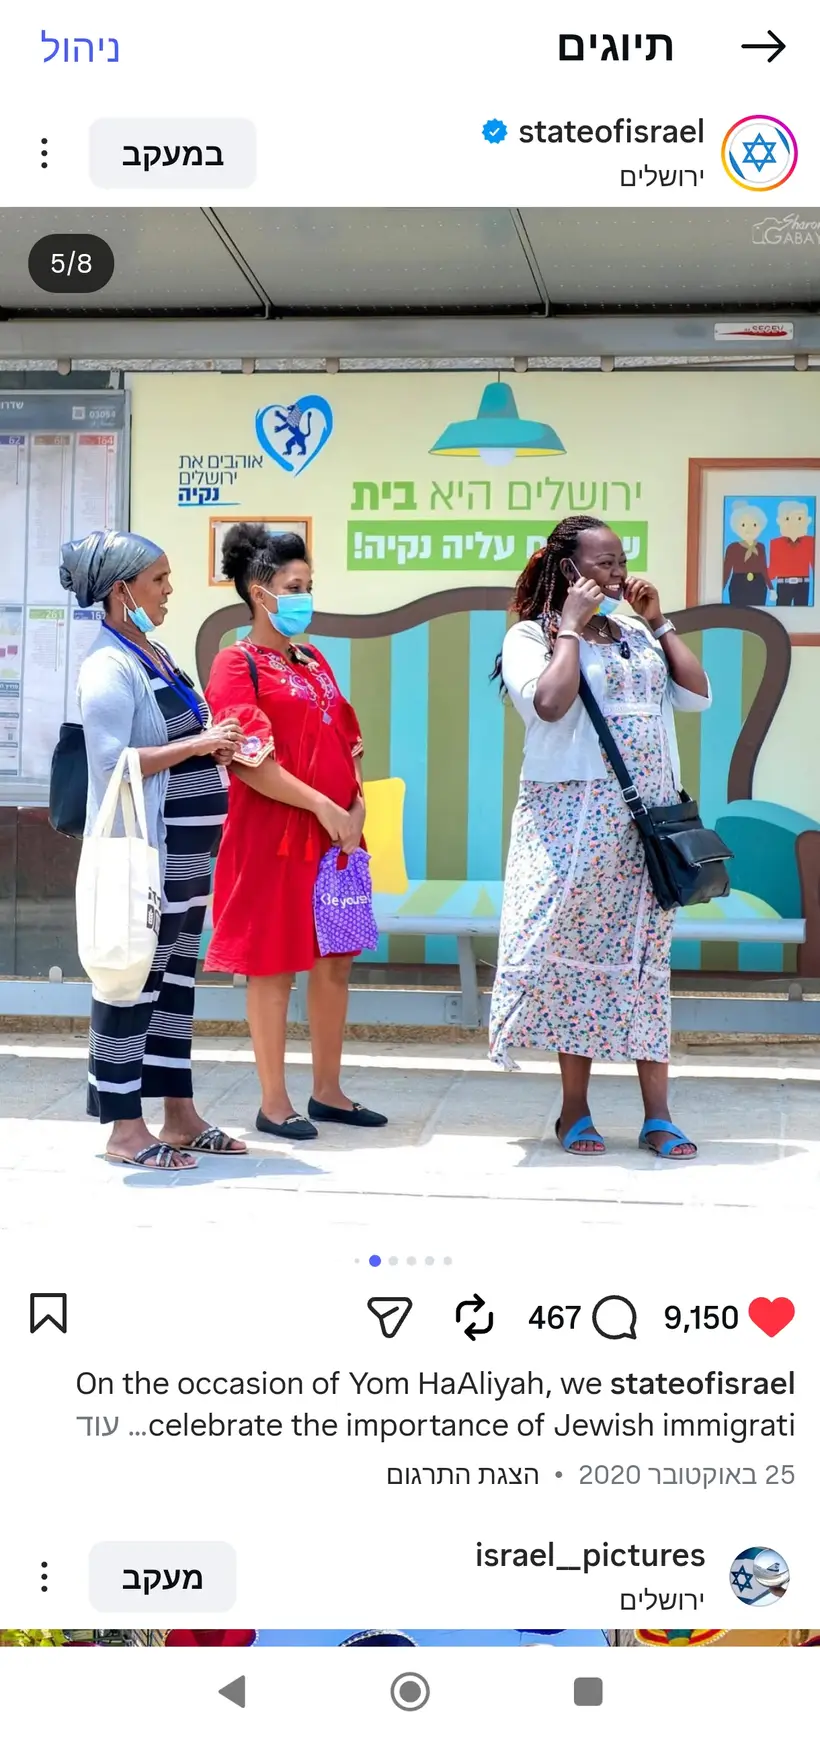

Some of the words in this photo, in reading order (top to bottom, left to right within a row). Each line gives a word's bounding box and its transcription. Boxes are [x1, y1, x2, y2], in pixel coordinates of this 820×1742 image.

[178, 455, 203, 469] את
[179, 470, 237, 485] ירושלים
[208, 455, 263, 469] אוהבים
[178, 487, 220, 505] נקיה
[350, 480, 417, 511] בית
[430, 480, 491, 511] היא
[508, 476, 641, 511] ירושלים
[353, 531, 432, 565] נקיה!
[442, 531, 515, 562] עליה
